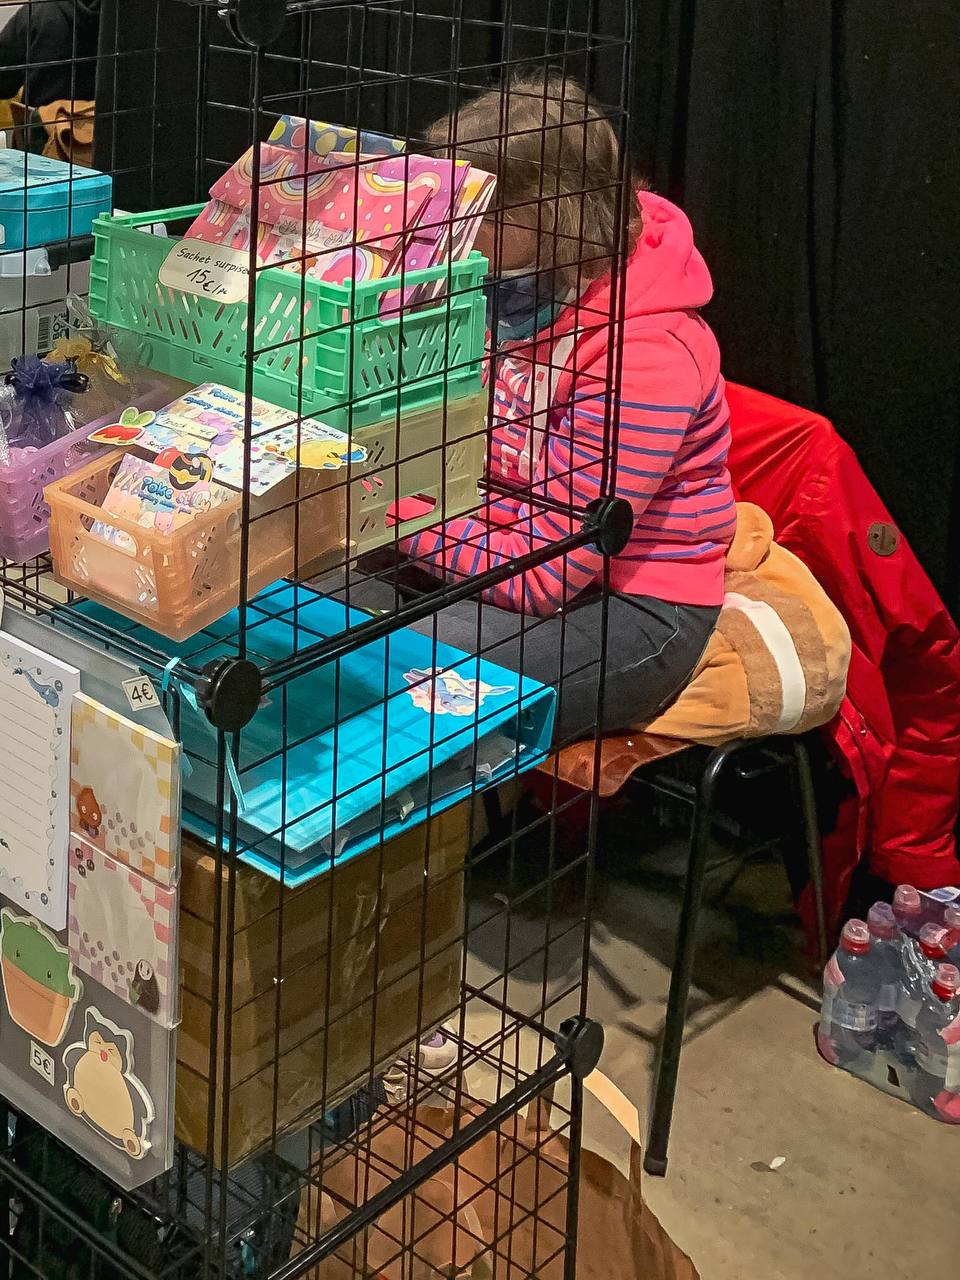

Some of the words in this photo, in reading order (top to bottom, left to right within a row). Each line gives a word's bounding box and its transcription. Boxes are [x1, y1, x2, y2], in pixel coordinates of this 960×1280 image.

[176, 247, 212, 264] Sachet
[131, 682, 154, 703] 4€
[33, 1049, 51, 1075] 5€
